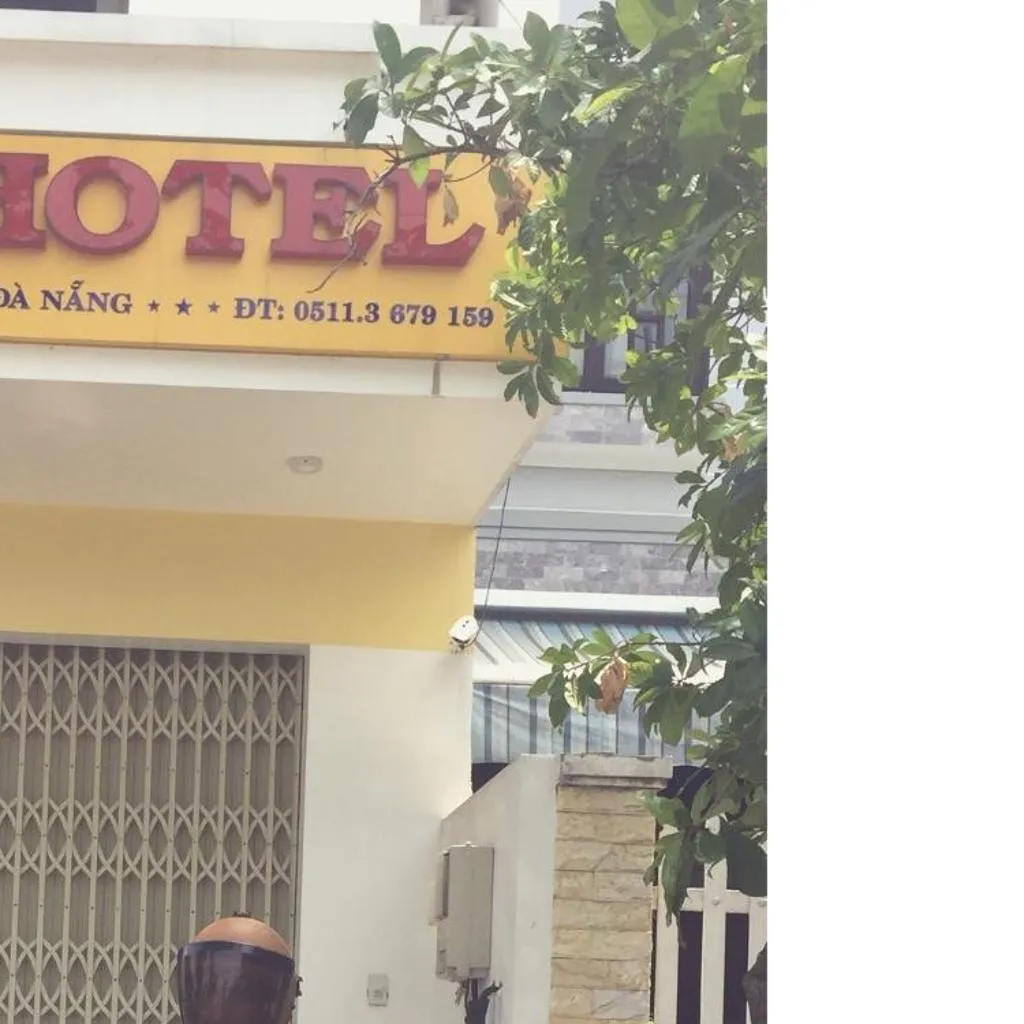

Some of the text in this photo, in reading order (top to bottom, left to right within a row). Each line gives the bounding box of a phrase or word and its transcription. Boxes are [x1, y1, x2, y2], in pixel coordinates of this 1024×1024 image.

[40, 280, 133, 314] NẴNG
[233, 298, 284, 320] ĐT:
[294, 300, 380, 323] 0511.3
[390, 303, 436, 326] 679
[448, 306, 494, 327] 159
